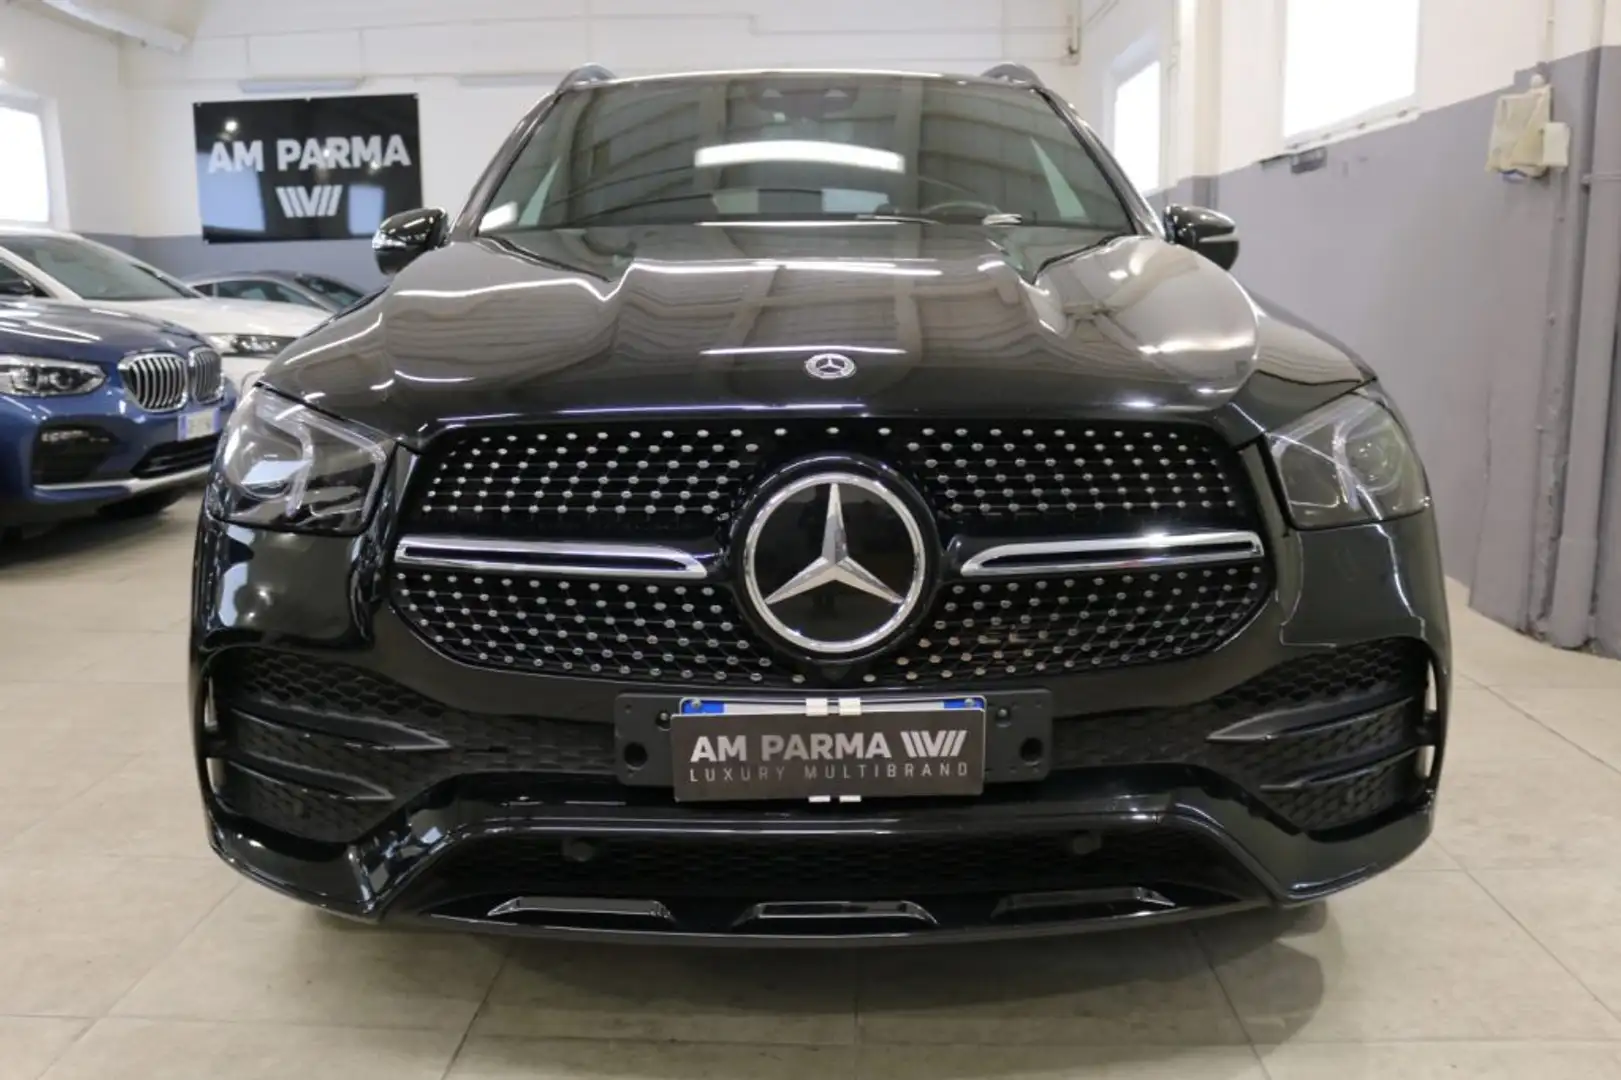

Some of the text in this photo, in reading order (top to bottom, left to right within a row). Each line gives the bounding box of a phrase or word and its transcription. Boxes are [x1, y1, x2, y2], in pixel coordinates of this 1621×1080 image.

[208, 134, 412, 173] AM PARMA
[690, 732, 893, 763] AM PARMA
[689, 761, 968, 783] LUXURY MULTIBRAND
